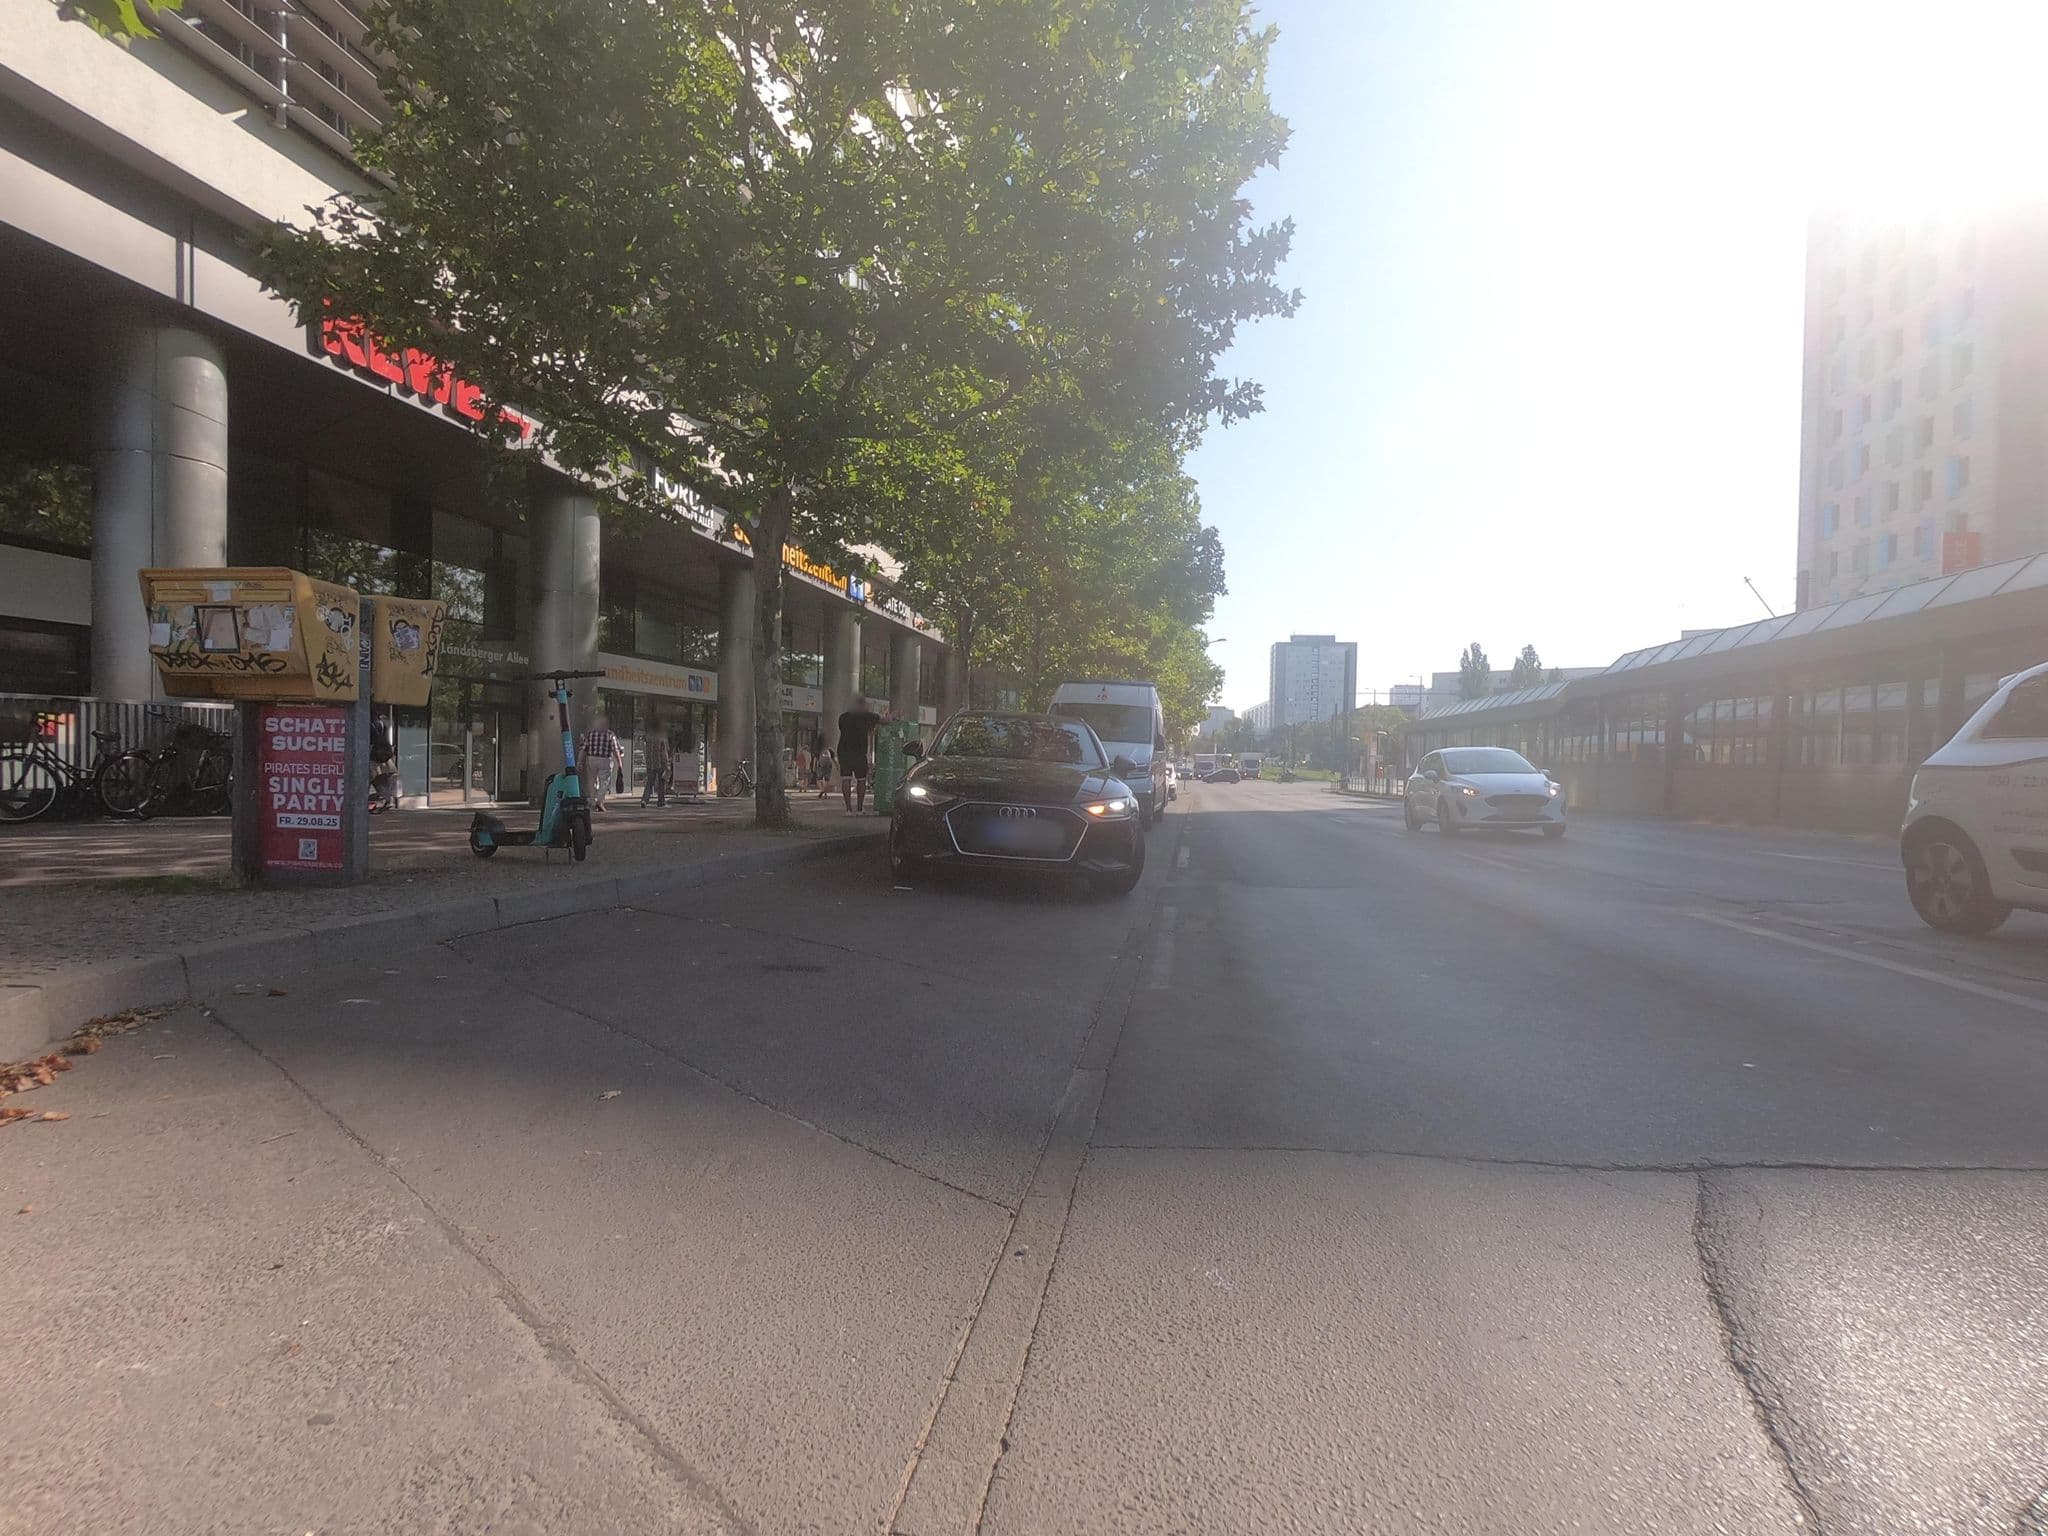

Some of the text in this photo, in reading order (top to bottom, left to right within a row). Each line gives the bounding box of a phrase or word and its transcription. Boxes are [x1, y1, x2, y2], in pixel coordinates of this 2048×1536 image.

[440, 641, 529, 665] Landsberger Allee
[271, 736, 345, 752] SUCHE
[264, 762, 310, 774] PIRATES
[269, 777, 345, 794] SINGLE
[273, 794, 345, 812] PARTY
[279, 816, 338, 827] FR. 29.08.25
